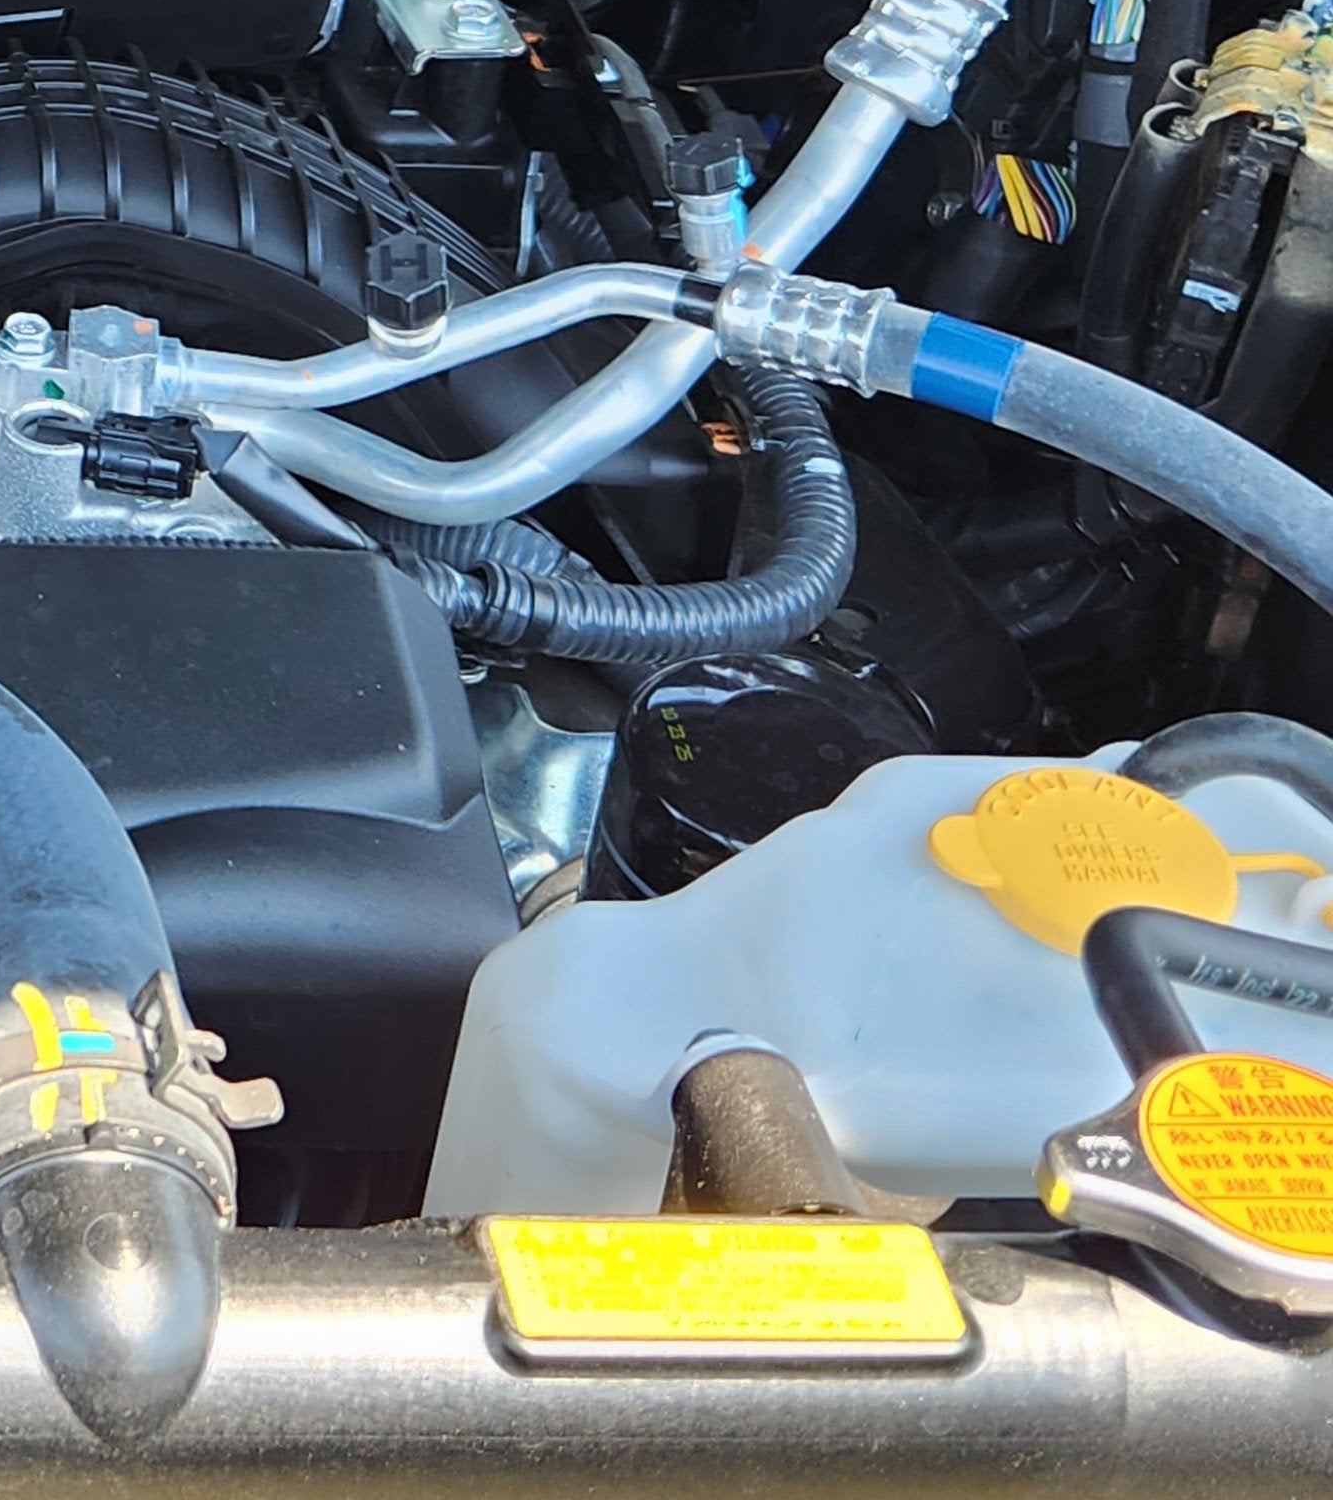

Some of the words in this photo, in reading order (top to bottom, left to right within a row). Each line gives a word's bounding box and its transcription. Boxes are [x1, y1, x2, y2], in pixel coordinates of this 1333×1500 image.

[988, 771, 1181, 823] COOLANT
[1062, 822, 1118, 841] SEE
[1062, 863, 1162, 884] MANUAL
[1207, 1064, 1286, 1091] 警告
[1176, 1153, 1235, 1169] NEVER
[1243, 1153, 1290, 1169] OPEN
